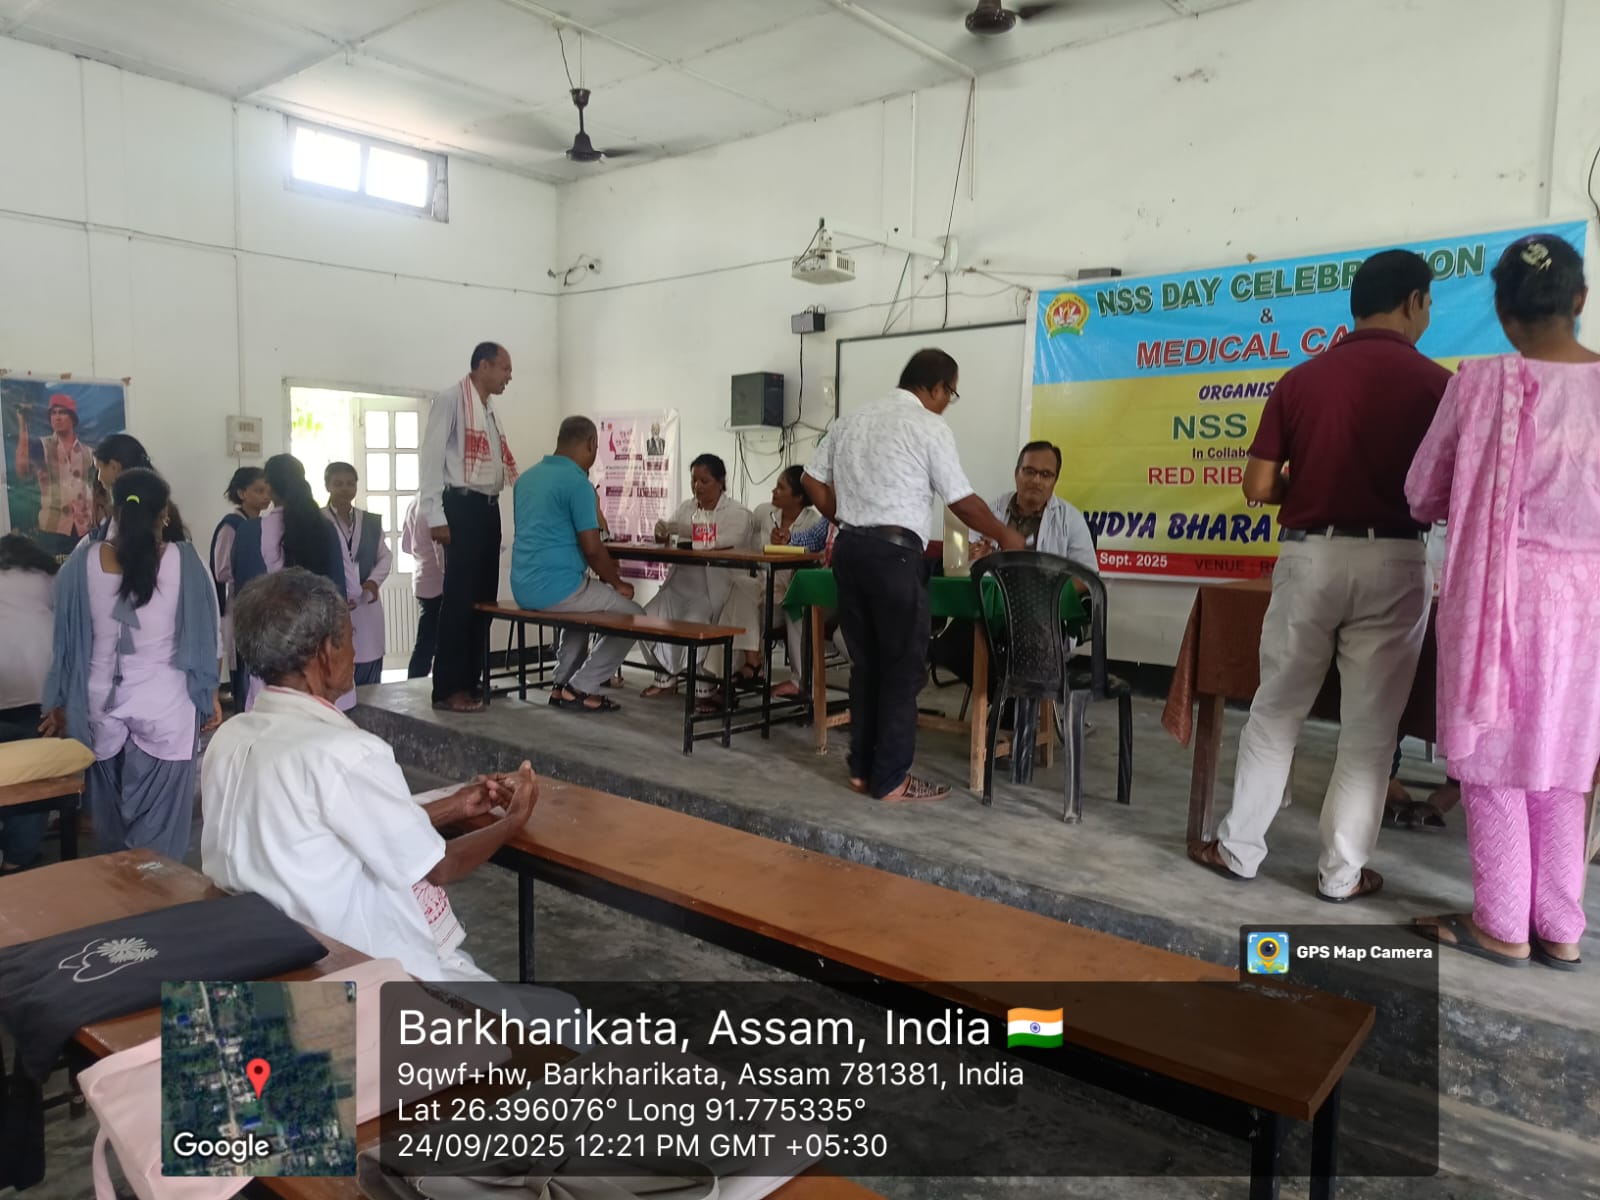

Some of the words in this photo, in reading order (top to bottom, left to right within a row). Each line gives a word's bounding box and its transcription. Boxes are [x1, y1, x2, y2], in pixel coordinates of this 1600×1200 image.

[1097, 285, 1152, 317] NSS
[1161, 276, 1222, 310] DAY
[1230, 244, 1485, 300] CELEBRON
[1259, 307, 1273, 324] &
[1136, 332, 1289, 368] MEDICAL
[1300, 323, 1350, 355] CA
[1198, 382, 1278, 401] ORGANIS
[1172, 413, 1247, 441] NSS
[1192, 448, 1203, 459] In
[1148, 467, 1195, 485] RED
[1203, 466, 1243, 485] RIB
[1167, 513, 1285, 544] BHARA
[1100, 552, 1132, 568] Sept.
[1136, 554, 1168, 568] 2025
